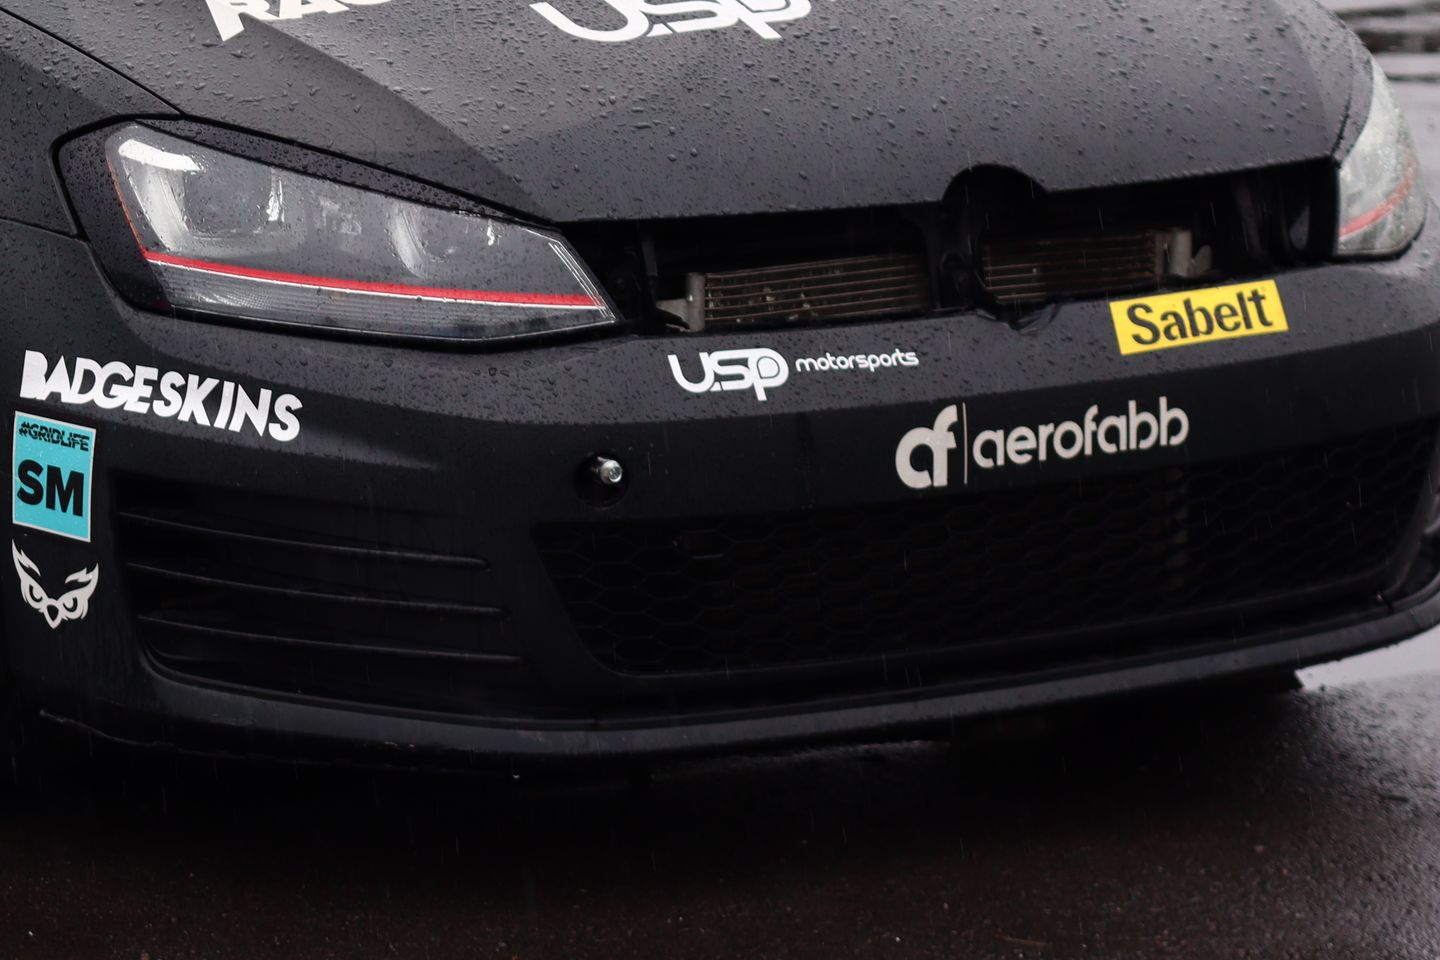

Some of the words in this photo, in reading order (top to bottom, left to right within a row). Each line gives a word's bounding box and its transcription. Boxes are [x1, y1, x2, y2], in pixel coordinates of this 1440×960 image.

[1128, 279, 1275, 344] Sabelt
[795, 348, 920, 372] motorsports
[19, 349, 303, 442] BADGESKINS
[18, 420, 90, 452] #GRIDLIFE
[973, 396, 1190, 468] aerofabb
[16, 458, 85, 518] SM
